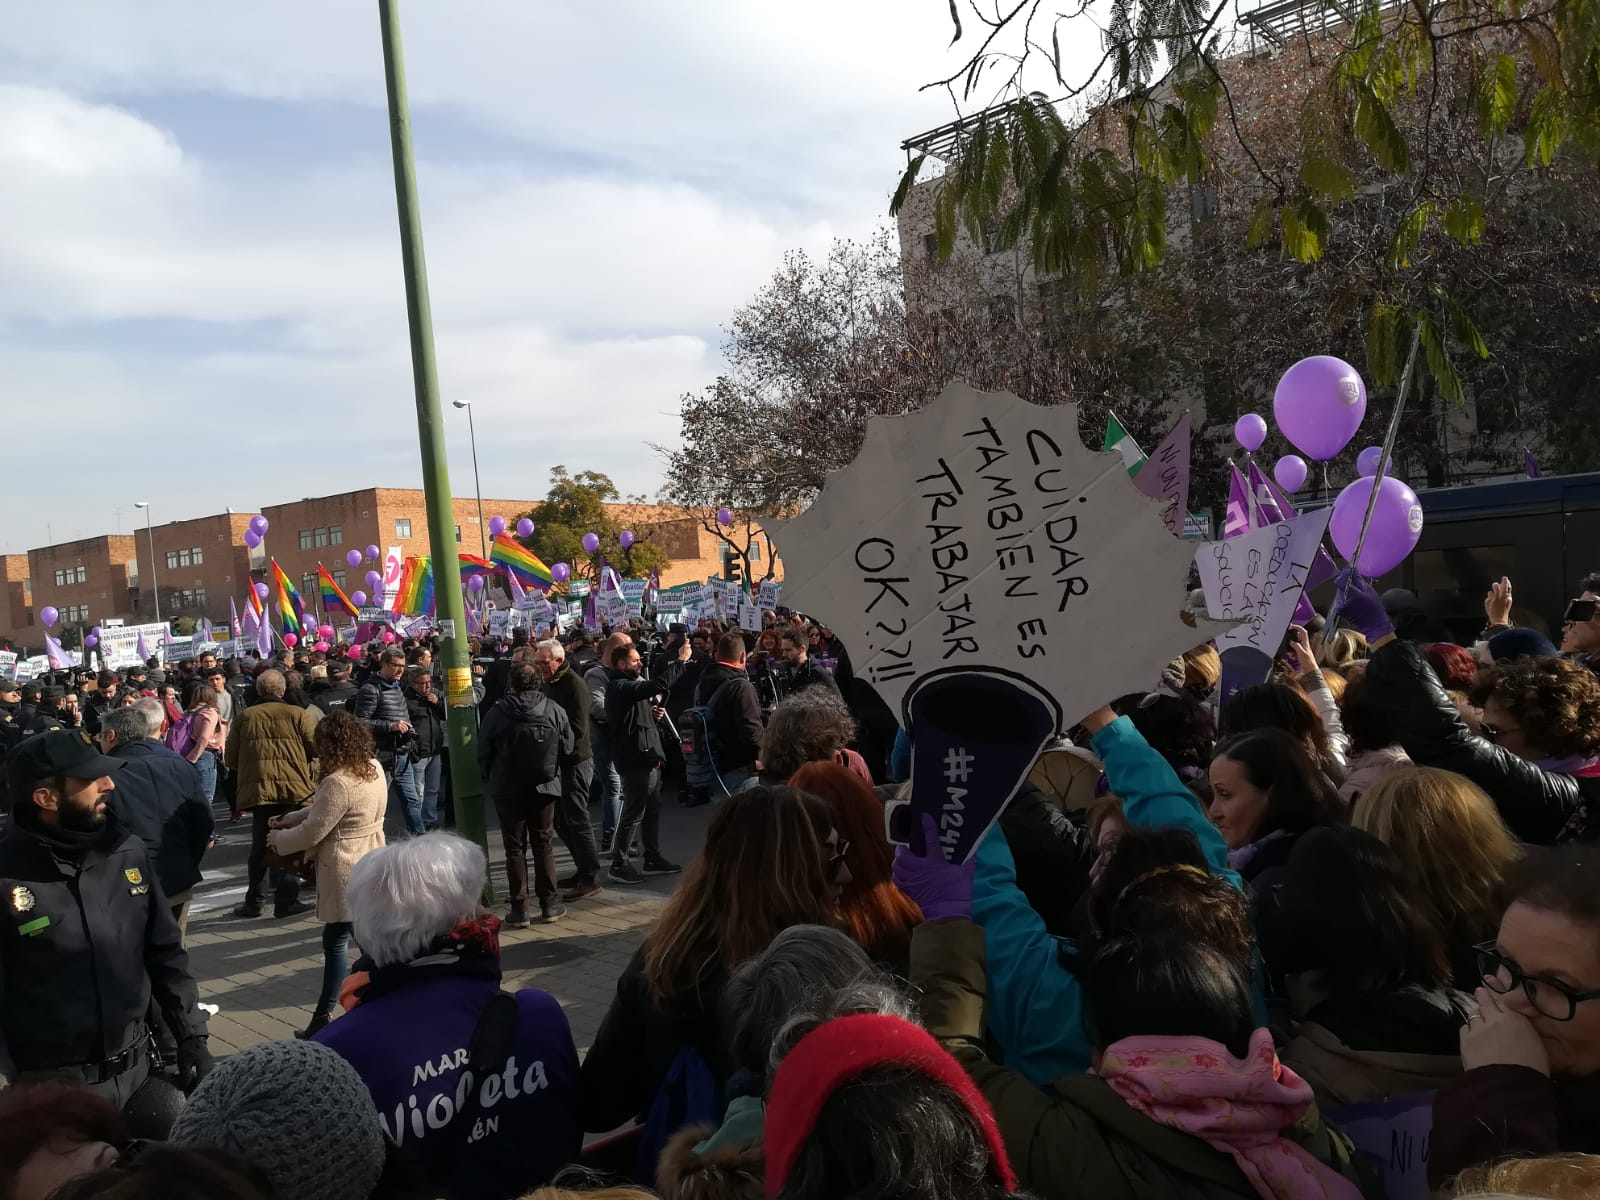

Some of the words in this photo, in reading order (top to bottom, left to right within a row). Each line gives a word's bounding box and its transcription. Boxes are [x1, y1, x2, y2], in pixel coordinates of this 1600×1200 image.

[1160, 443, 1181, 464] NI
[1161, 466, 1180, 492] UN
[915, 458, 979, 659] TRABAJAR
[1248, 549, 1261, 579] ES
[1247, 524, 1292, 646] COEDUCACIÓN
[1280, 561, 1308, 593] LA
[1239, 582, 1257, 611] LA
[1017, 618, 1047, 658] ES
[413, 1048, 470, 1087] MAR
[378, 1055, 548, 1148] Violeta
